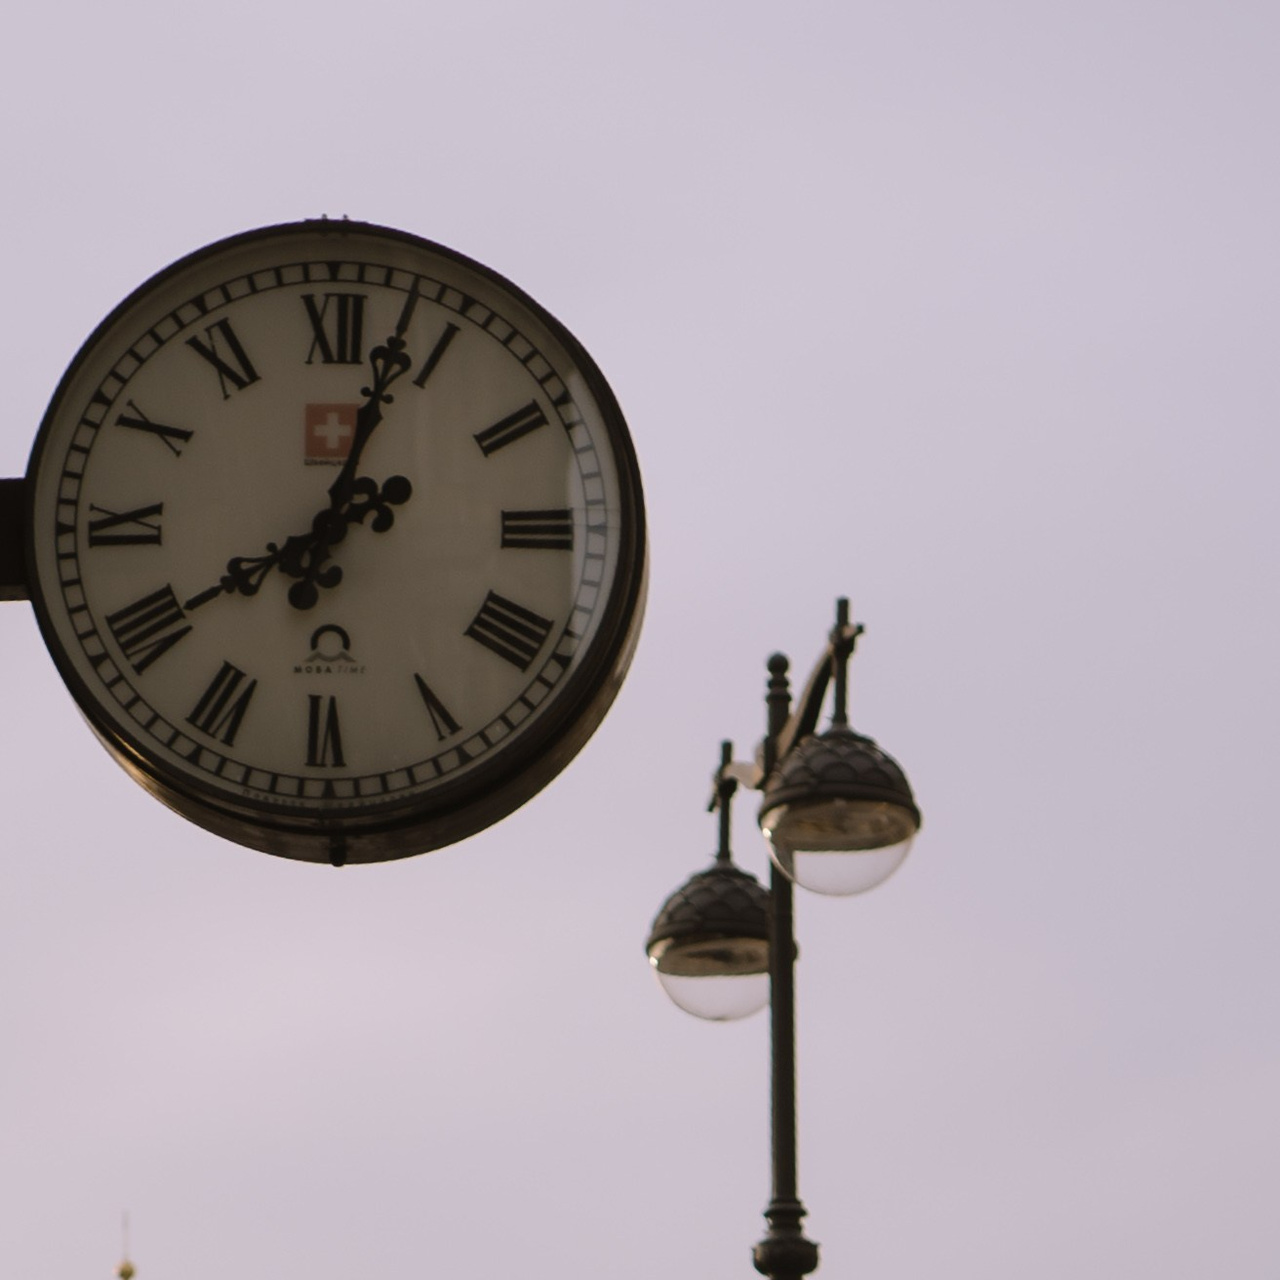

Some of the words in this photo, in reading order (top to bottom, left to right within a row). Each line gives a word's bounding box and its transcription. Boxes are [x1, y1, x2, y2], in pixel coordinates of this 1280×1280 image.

[186, 318, 261, 399] XI
[302, 294, 367, 364] XII
[413, 323, 460, 388] I
[116, 401, 193, 456] X
[473, 400, 548, 456] II
[89, 503, 162, 548] IX
[501, 508, 573, 550] III
[106, 584, 192, 674] VIII
[186, 661, 256, 746] VII
[307, 695, 345, 767] VI
[414, 673, 461, 740] V
